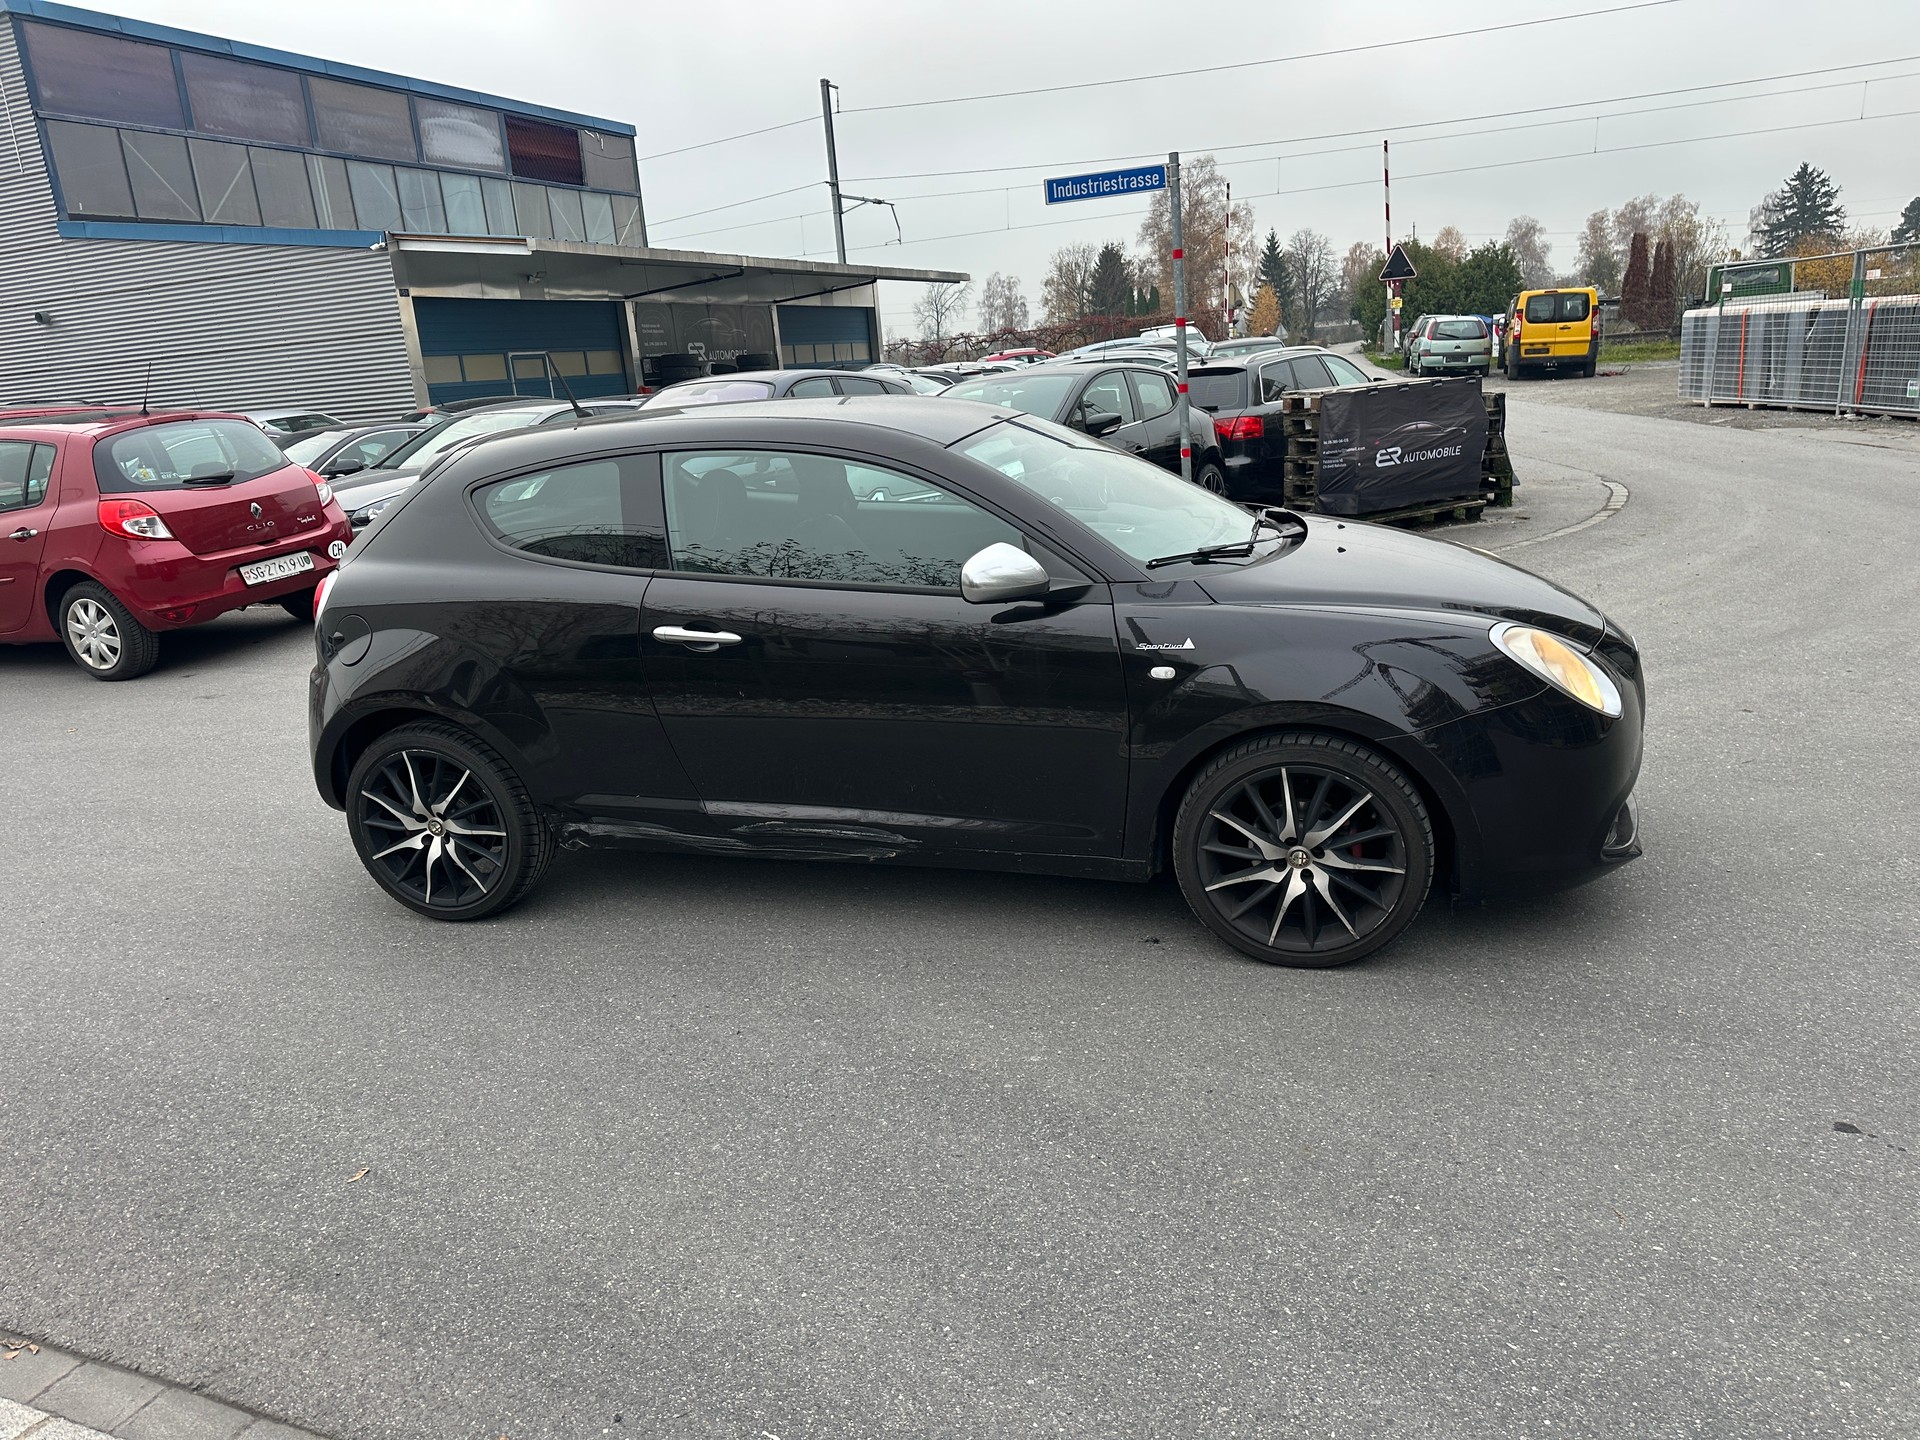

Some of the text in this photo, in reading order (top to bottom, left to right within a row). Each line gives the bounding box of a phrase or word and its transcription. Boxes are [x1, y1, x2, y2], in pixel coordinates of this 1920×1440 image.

[1053, 173, 1159, 198] Industriestrasse
[1375, 446, 1402, 468] ER
[1403, 445, 1462, 463] AUTOMOBILE
[247, 520, 275, 531] CLIO
[331, 540, 343, 557] CH
